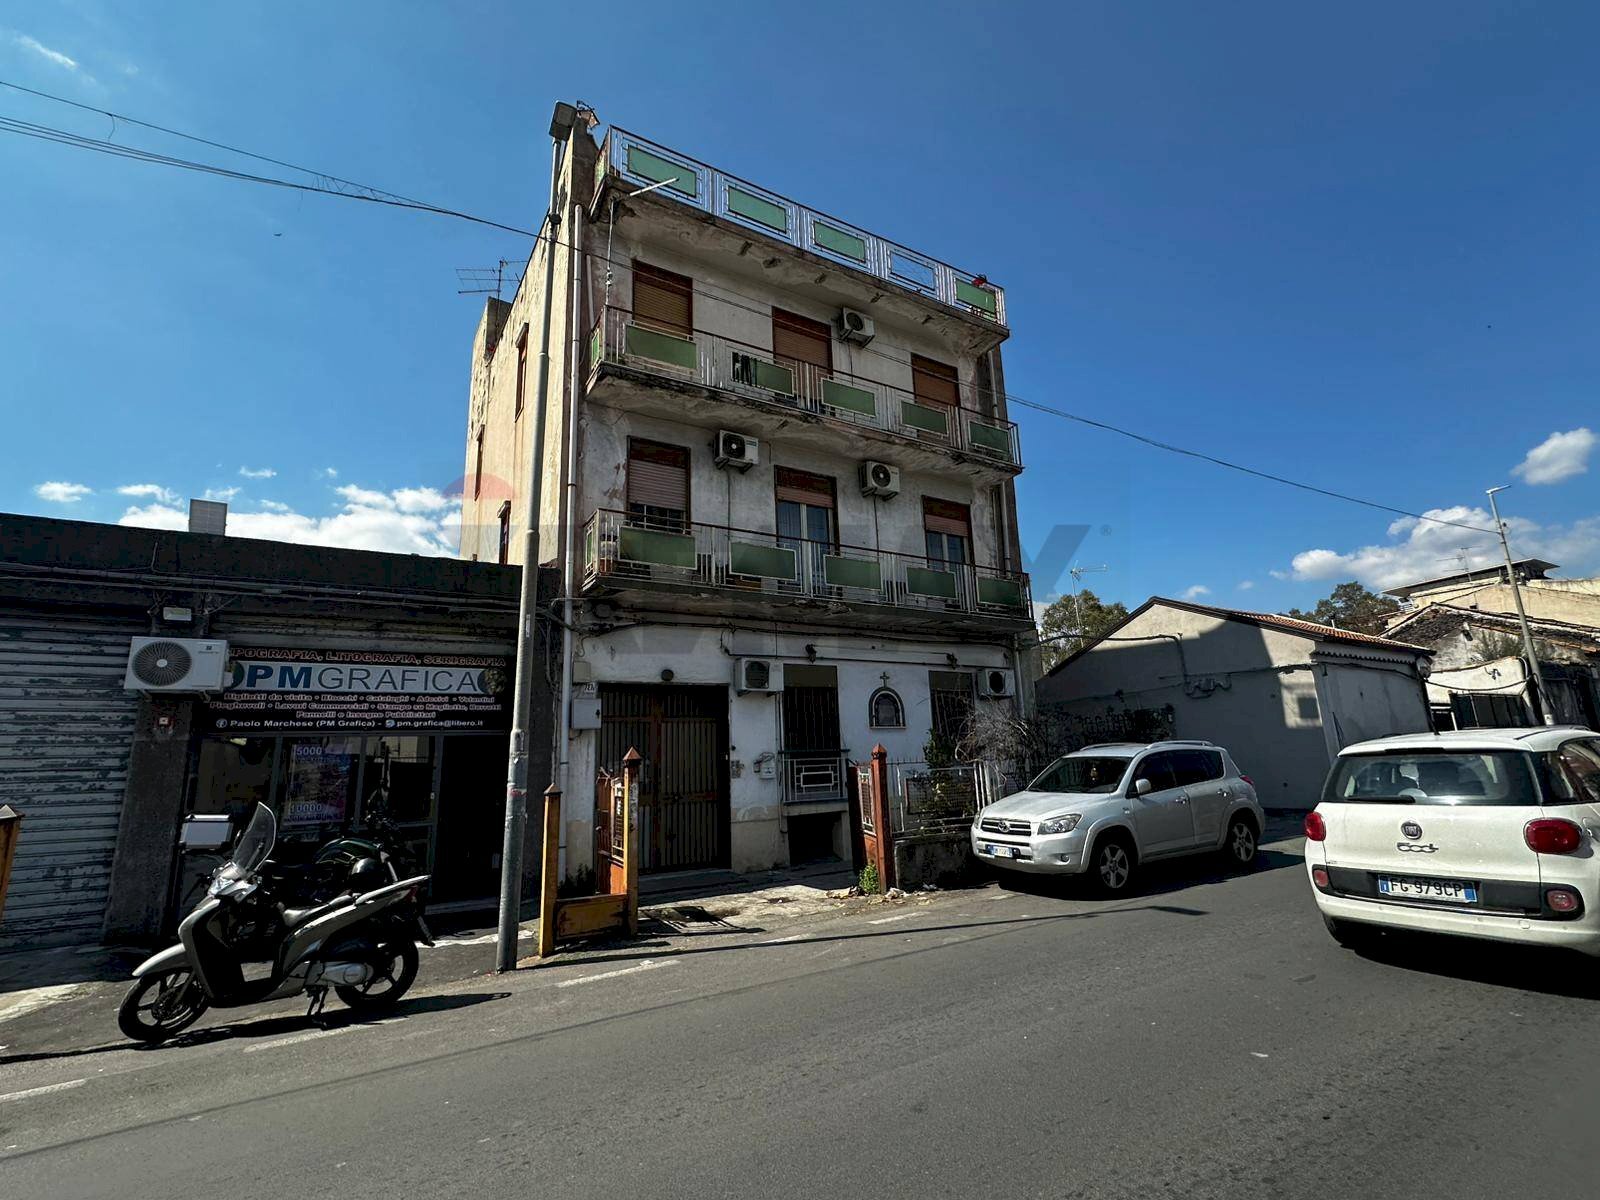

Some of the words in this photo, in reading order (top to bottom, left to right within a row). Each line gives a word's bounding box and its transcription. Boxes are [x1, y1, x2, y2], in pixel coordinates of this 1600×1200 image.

[423, 655, 506, 667] SERIGRAFIA
[230, 719, 261, 727] Paolo
[263, 719, 313, 728] Marchese
[316, 719, 336, 728] (PM
[338, 719, 376, 728] Grafica)
